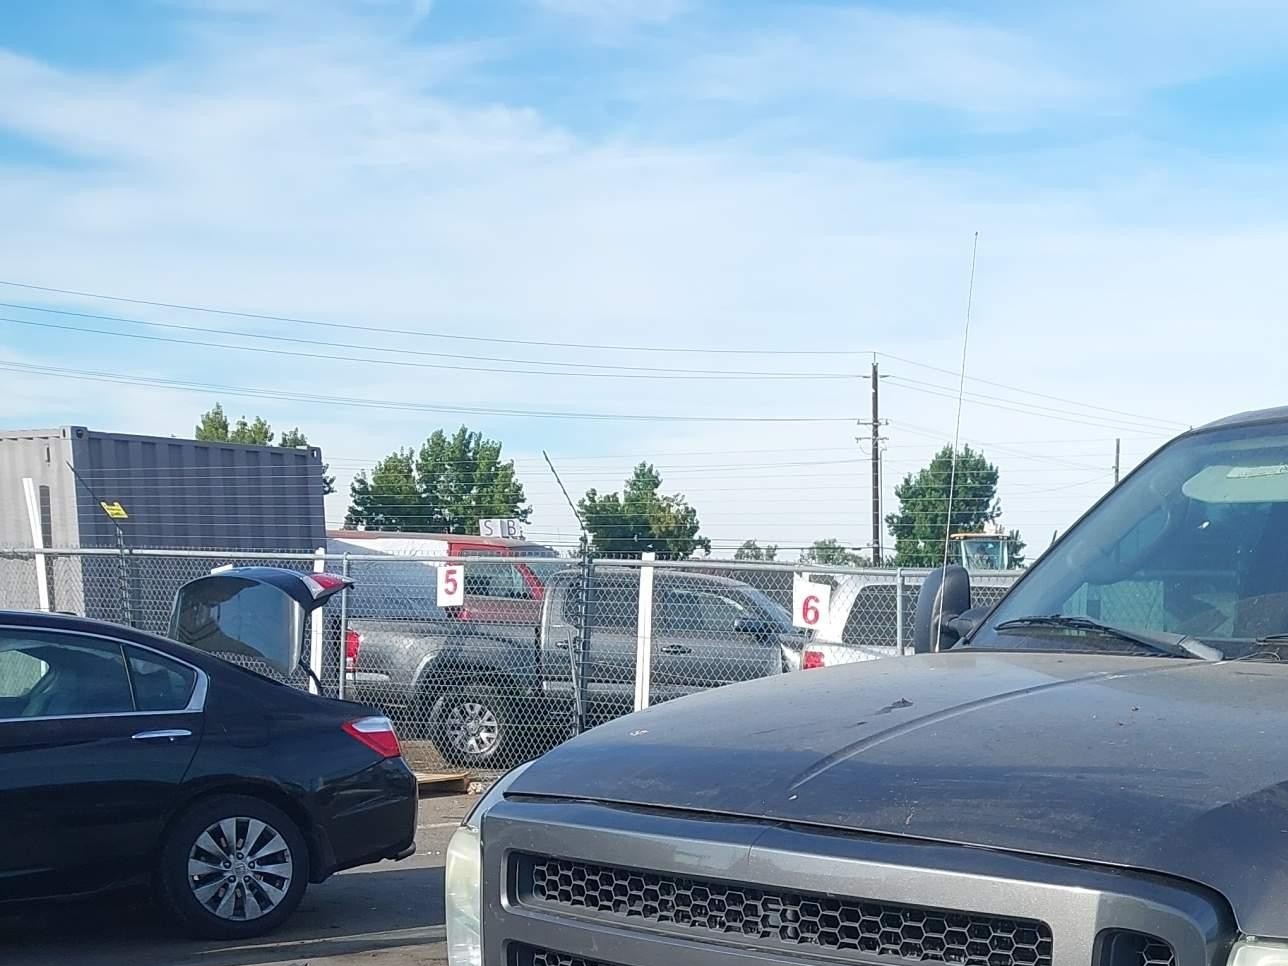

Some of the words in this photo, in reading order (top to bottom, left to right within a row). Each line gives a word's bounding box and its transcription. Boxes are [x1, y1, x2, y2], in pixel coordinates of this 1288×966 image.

[484, 519, 493, 536] S
[506, 519, 516, 536] B
[444, 569, 458, 595] 5
[802, 595, 820, 625] 6
